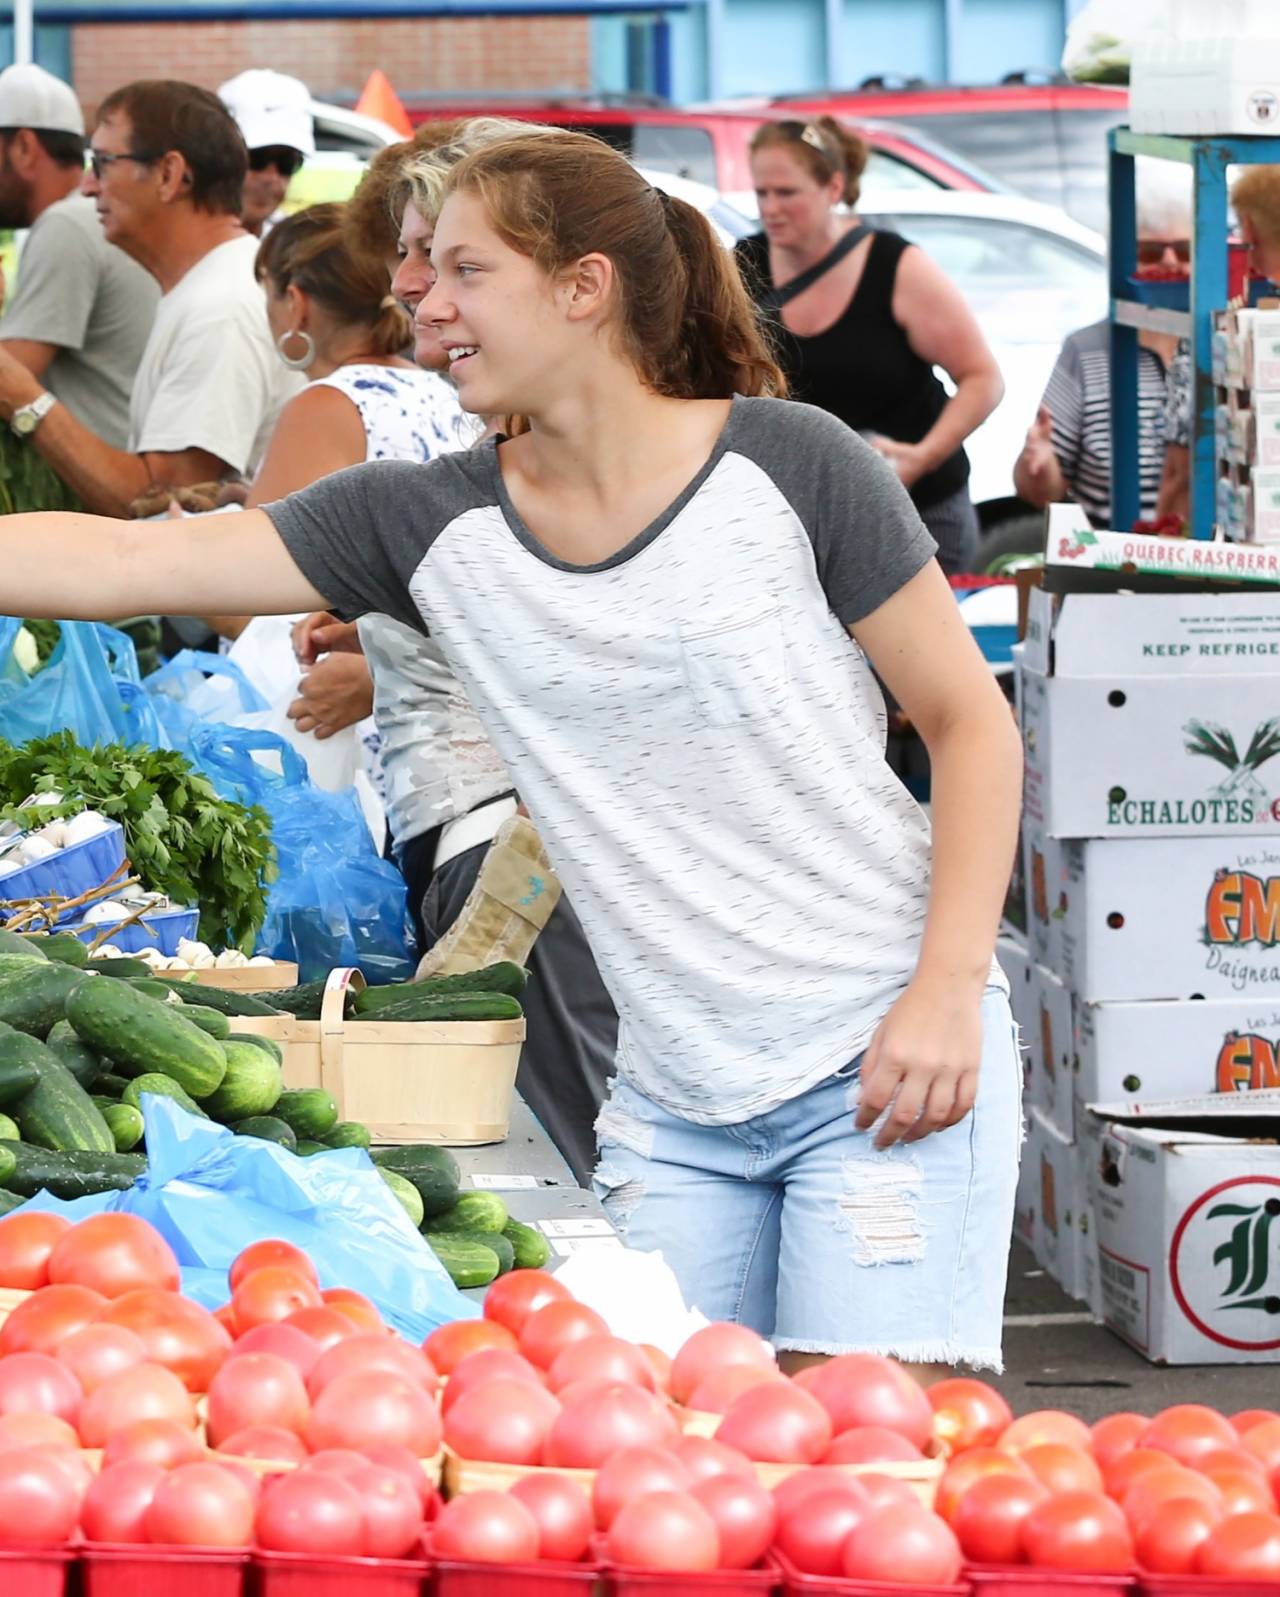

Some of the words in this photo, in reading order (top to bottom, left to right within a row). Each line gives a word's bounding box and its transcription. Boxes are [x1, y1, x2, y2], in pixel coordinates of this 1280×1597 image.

[1123, 542, 1185, 563] QUEBEC
[1142, 643, 1191, 656] KEEP
[1199, 642, 1280, 656] REFRIGE
[1107, 800, 1255, 824] ECHALOTES
